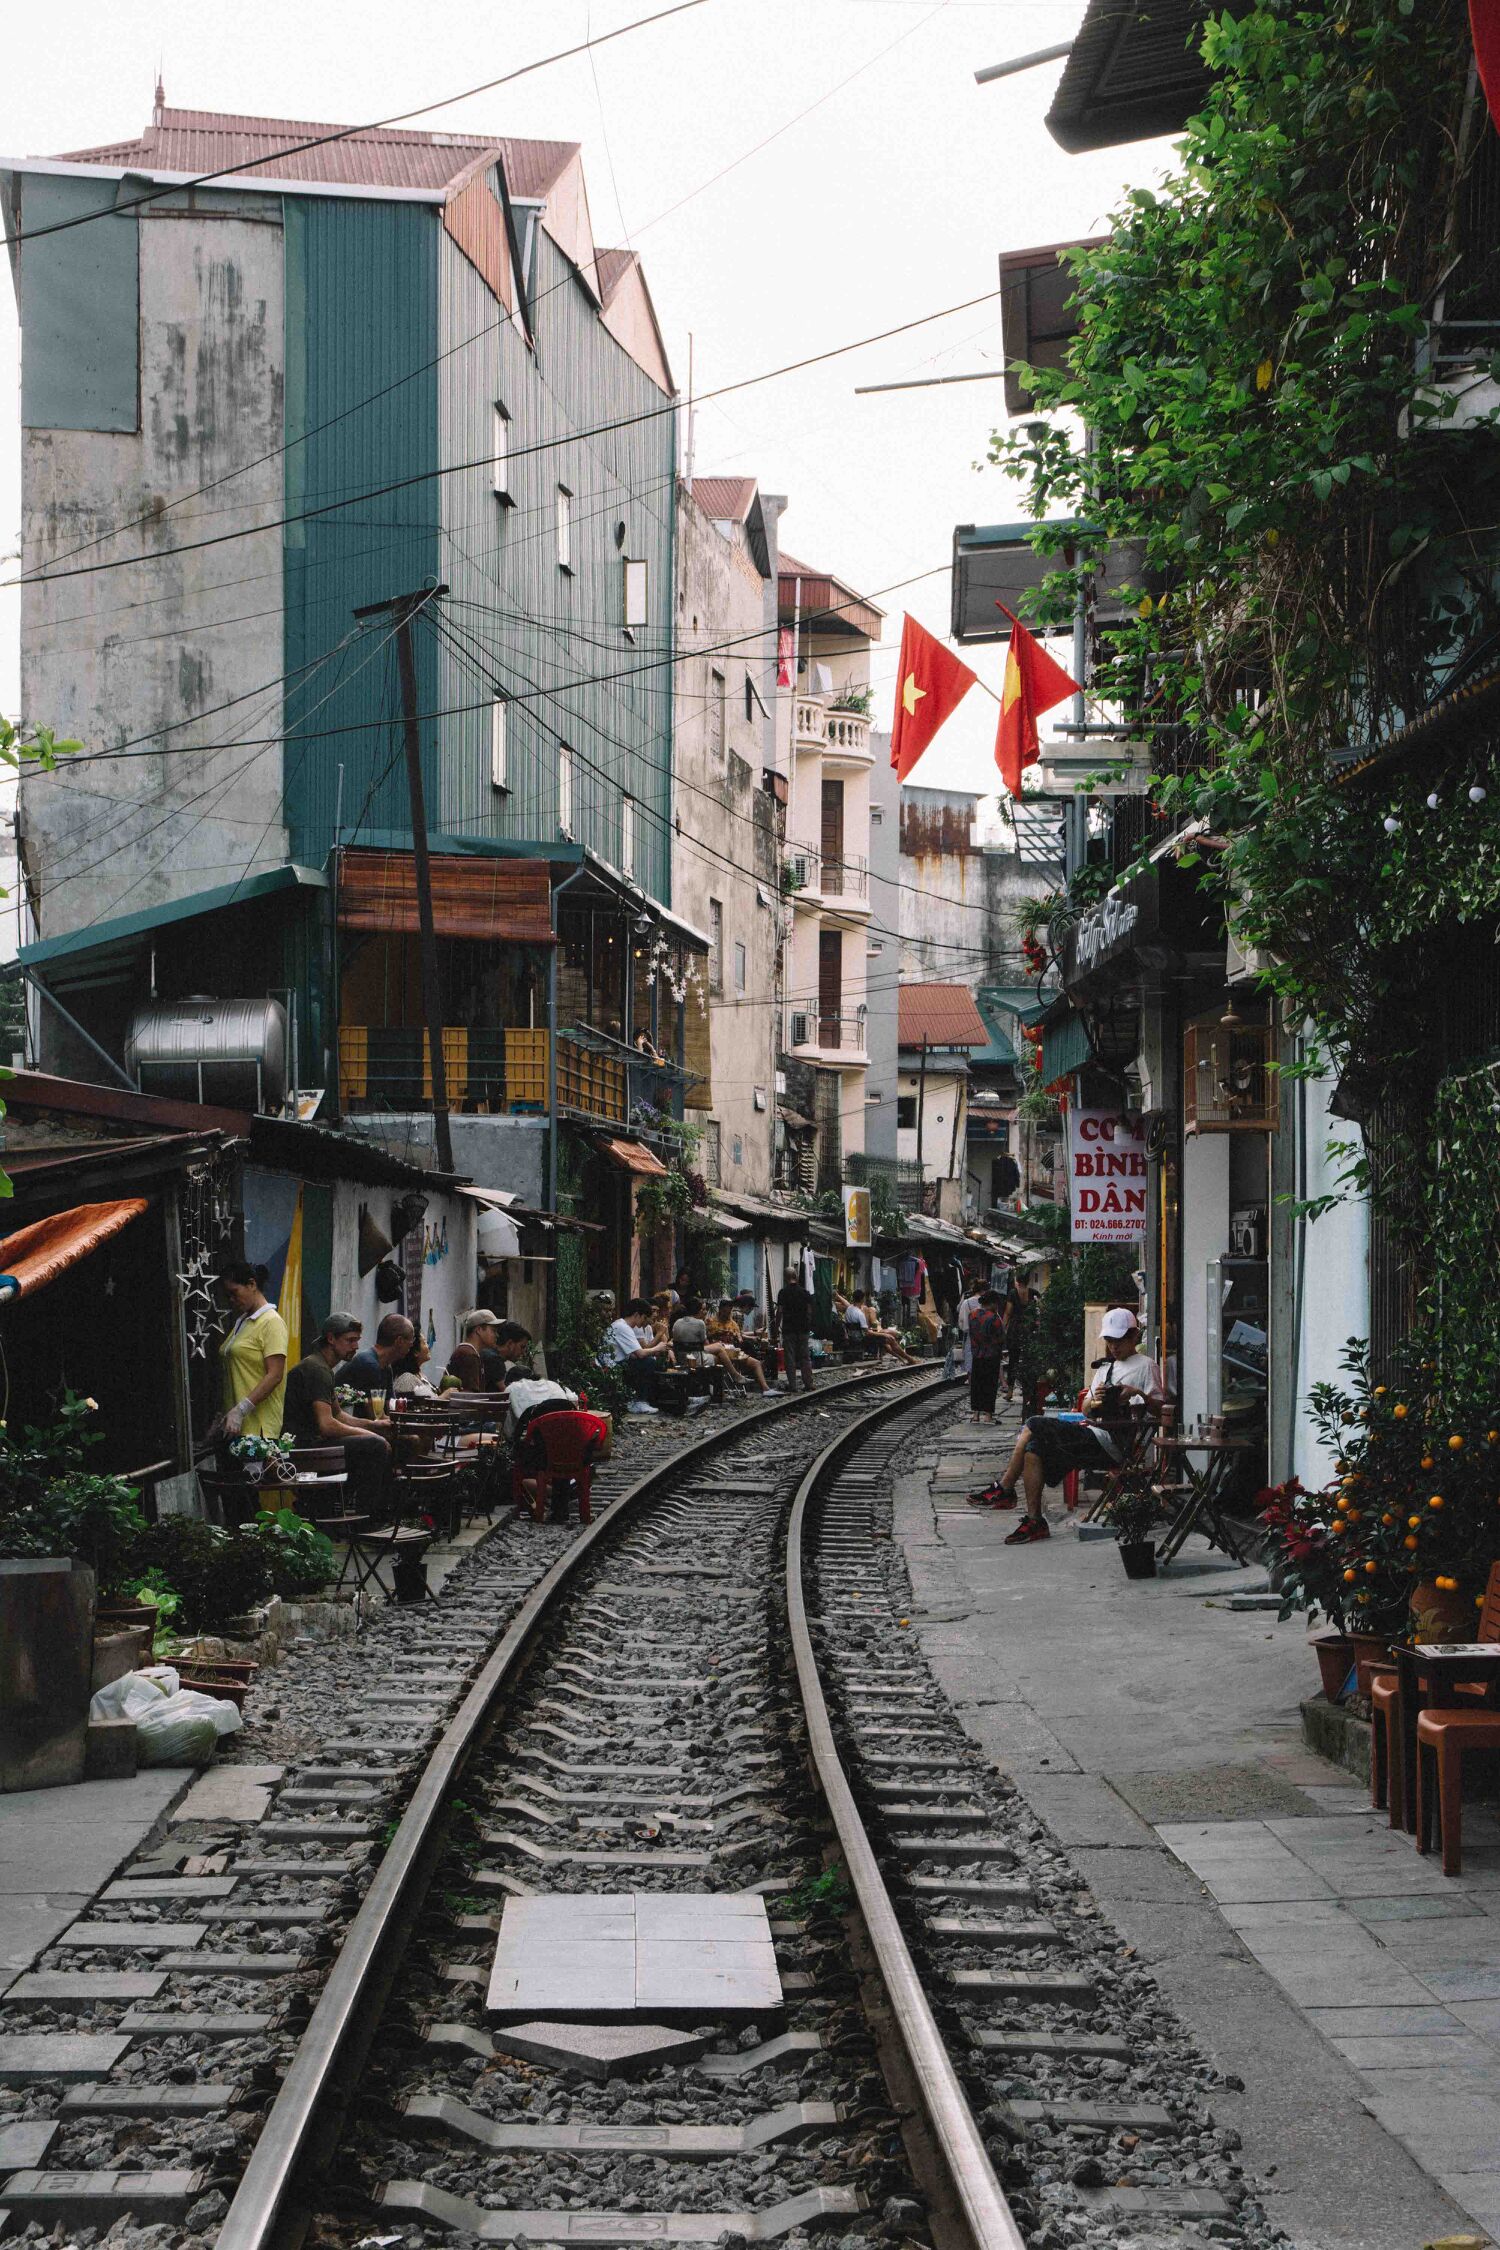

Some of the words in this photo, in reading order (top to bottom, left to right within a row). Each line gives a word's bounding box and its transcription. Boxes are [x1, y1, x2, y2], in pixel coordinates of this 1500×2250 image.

[1074, 1146, 1147, 1176] BÌNH
[1079, 1181, 1146, 1213] DÂN
[1074, 1219, 1088, 1230] ĐT:
